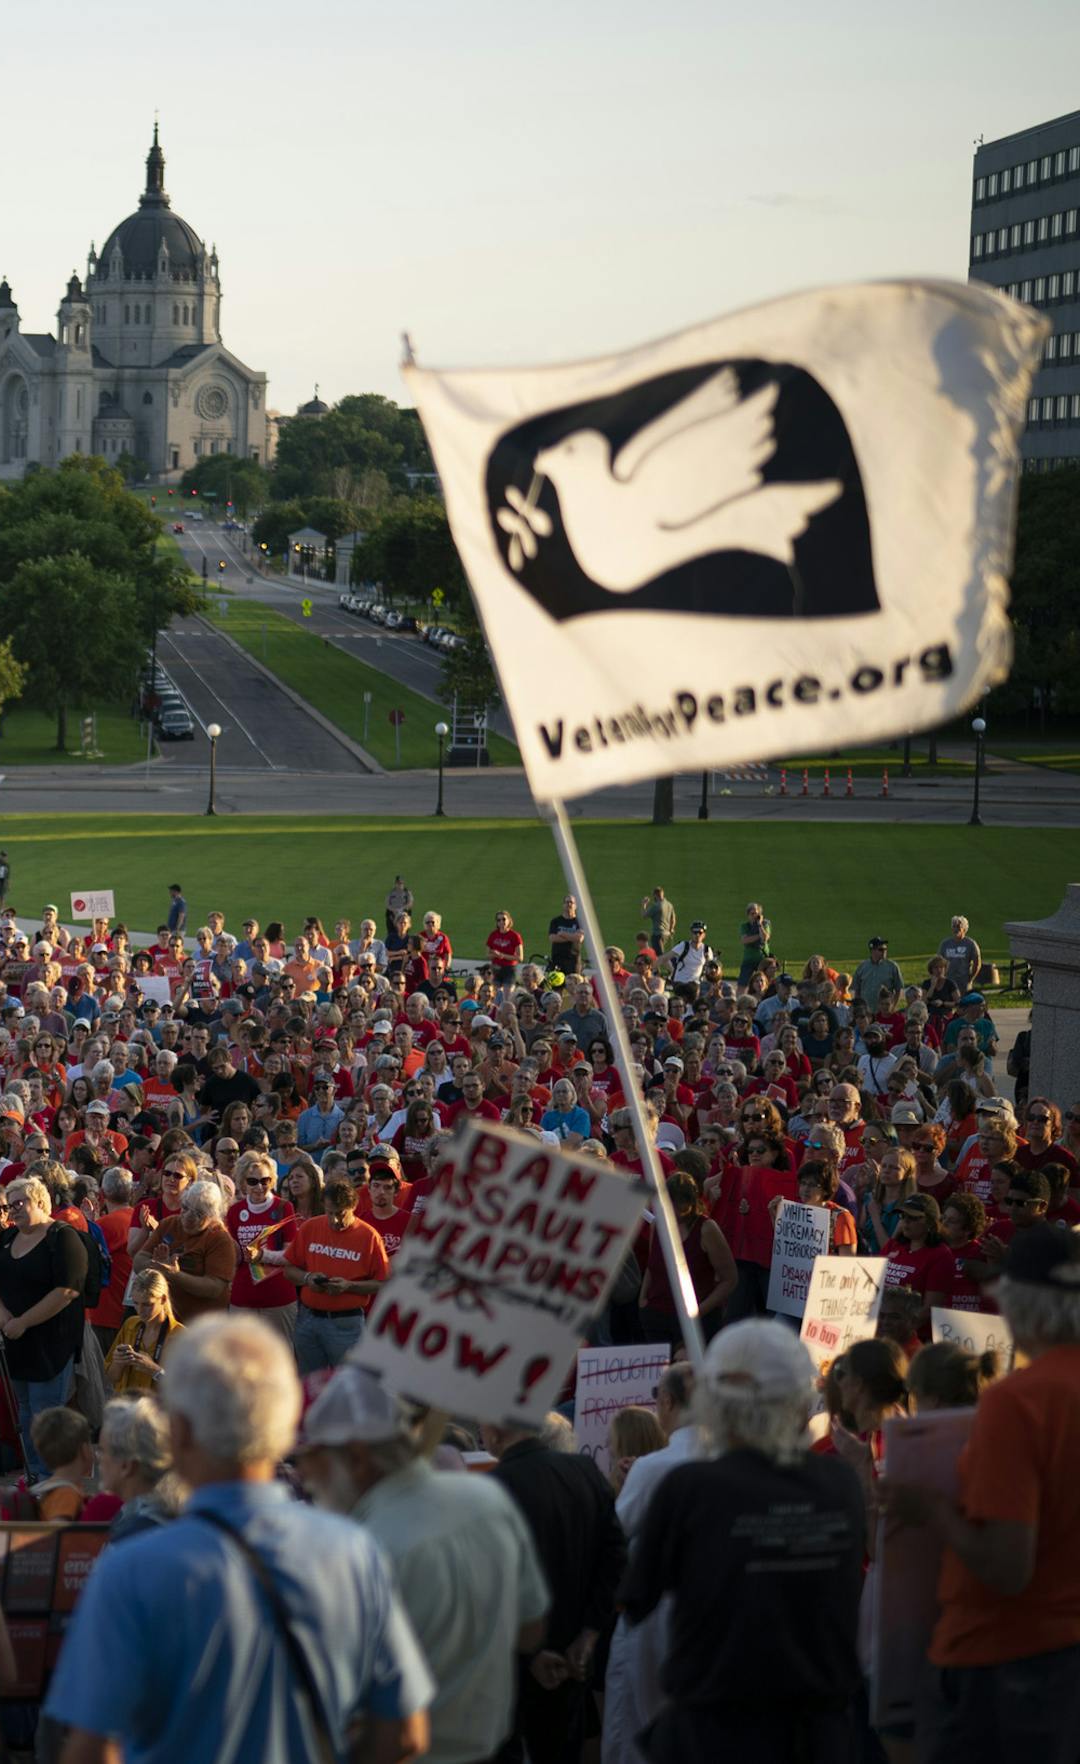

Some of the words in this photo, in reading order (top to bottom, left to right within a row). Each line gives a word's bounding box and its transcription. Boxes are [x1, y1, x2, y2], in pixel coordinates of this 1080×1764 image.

[469, 1134, 597, 1201] BAN
[431, 1160, 625, 1260] ASSAULT
[784, 1204, 812, 1224] WHITE
[776, 1218, 825, 1244] SUPREMACY
[309, 1242, 361, 1262] #DAYENU
[411, 1210, 608, 1301] WEAPONS
[820, 1270, 836, 1289] The
[806, 1322, 817, 1338] to
[820, 1326, 838, 1350] buy
